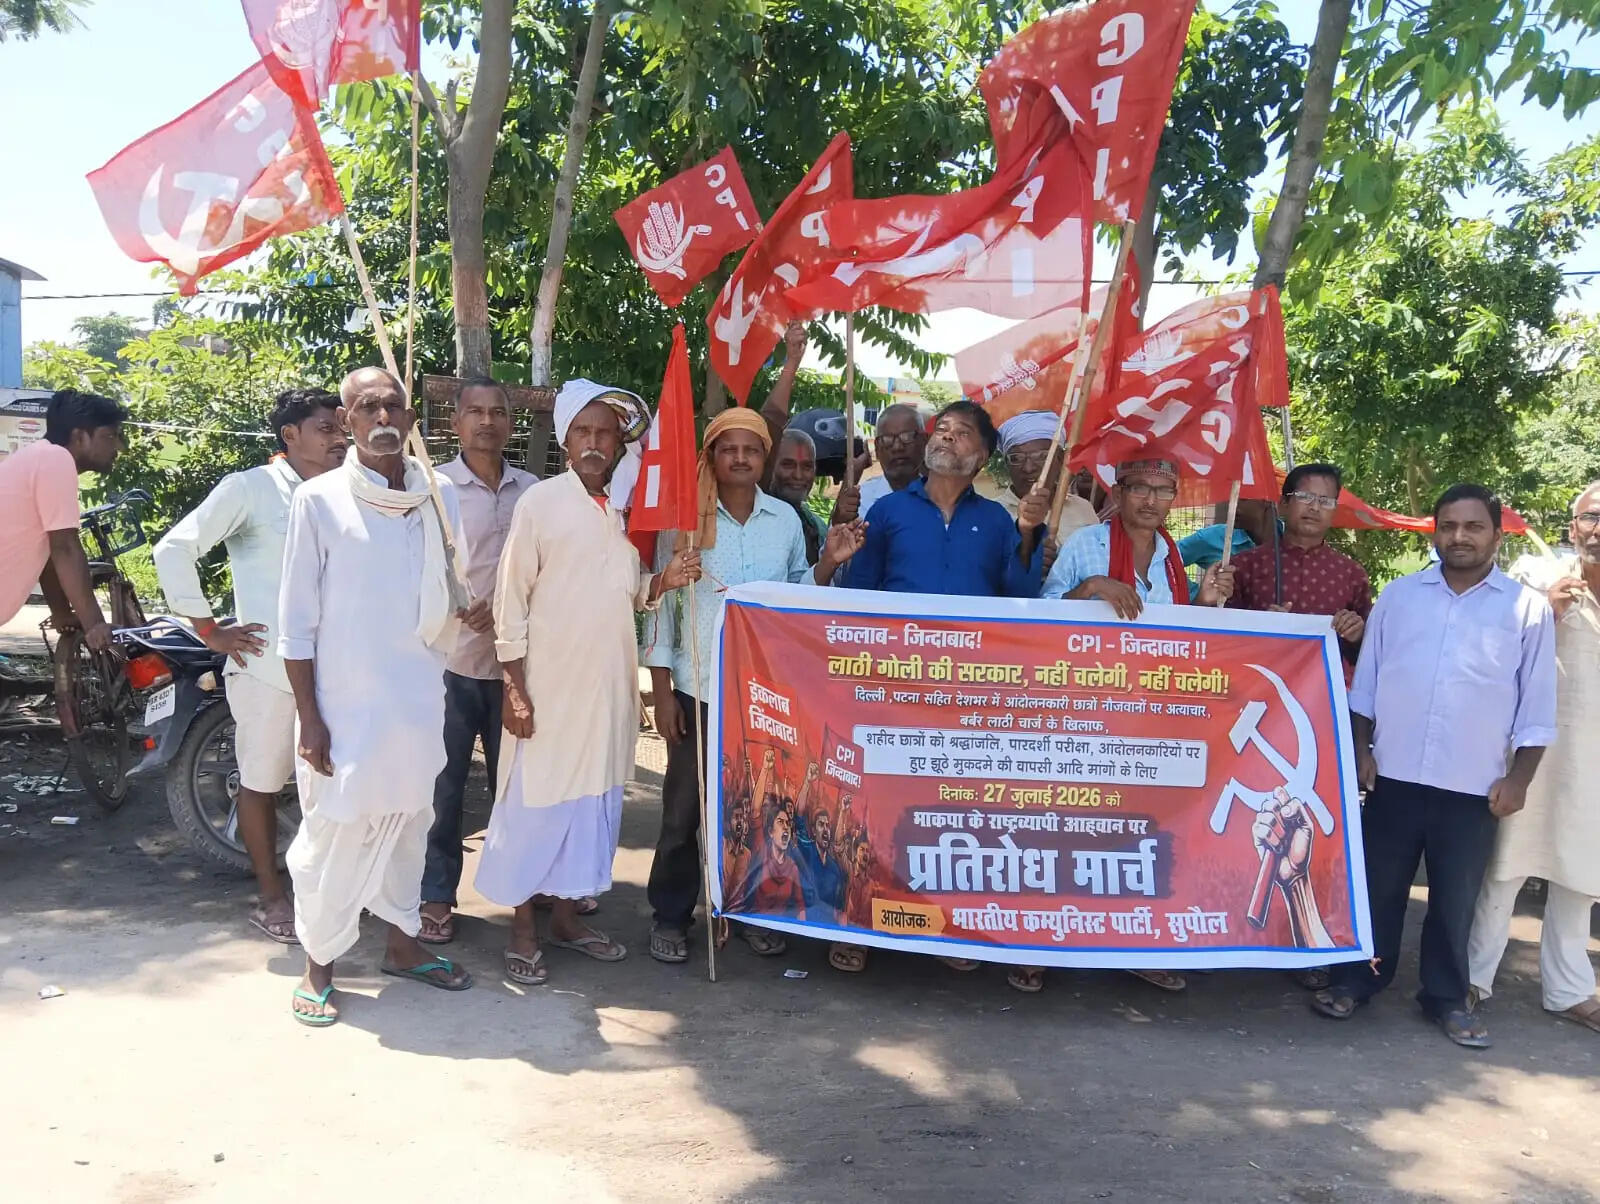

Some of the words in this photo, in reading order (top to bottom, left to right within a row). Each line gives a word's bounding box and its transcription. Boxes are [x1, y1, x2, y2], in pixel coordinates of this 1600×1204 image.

[904, 623, 983, 649] जिन्दाबाद!
[1067, 633, 1101, 653] CPI
[828, 652, 873, 677] लाठी
[877, 654, 923, 680] गोली
[928, 655, 952, 681] की
[957, 662, 1029, 688] सरकार,
[1034, 660, 1072, 686] नहीं
[1074, 662, 1133, 692] चलेगी,
[1139, 664, 1173, 690] नहीं
[1175, 667, 1230, 694] चलेगी!
[748, 677, 790, 716] इंकलाब
[855, 685, 886, 702] दिल्ली
[924, 690, 952, 707] सहित
[956, 690, 988, 708] देशभर
[991, 692, 1001, 707] में
[1004, 693, 1069, 710] आंदोलनकारी
[1073, 696, 1098, 711] छात्रों
[1102, 696, 1147, 714] नौजवानों
[1150, 702, 1162, 715] पर
[1166, 702, 1211, 719] अत्याचार,
[960, 711, 984, 728] बर्बर
[987, 713, 1014, 728] लाठी
[1018, 714, 1043, 729] चार्ज
[1046, 714, 1058, 730] के
[1063, 715, 1109, 734] खिलाफ,
[836, 745, 855, 766] CPI
[866, 729, 895, 747] शहीद
[899, 730, 926, 748] छात्रों
[930, 731, 945, 748] को
[949, 733, 1003, 752] श्रद्धांजलि,
[1008, 735, 1051, 752] पारदर्शी
[1055, 737, 1094, 756] परीक्षा,
[1098, 739, 1182, 758] आंदोलनकारियों
[1186, 746, 1200, 759] पर
[909, 756, 927, 774] हुए
[931, 753, 949, 775] झूठे
[953, 755, 993, 775] मुकदमे
[997, 755, 1013, 773] की
[1016, 757, 1052, 774] वापसी
[1056, 758, 1083, 777] आदि
[1087, 761, 1116, 777] मांगों
[1120, 761, 1131, 777] के
[1135, 764, 1158, 780] लिए
[983, 783, 1006, 803] 27
[1010, 784, 1053, 810] जुलाई
[1055, 785, 1101, 807] 2026
[1105, 790, 1122, 807] को
[967, 809, 985, 830] के
[987, 811, 1060, 834] राष्ट्रव्यापी
[1128, 818, 1149, 835] पर
[906, 832, 1059, 894] प्रतिरोध
[1072, 838, 1158, 896] मार्च
[881, 906, 931, 929] आयोजक:
[952, 902, 1019, 931] भारतीय
[1020, 904, 1106, 942] कम्युनिस्ट
[1109, 906, 1161, 940] पार्टी,
[1165, 905, 1229, 943] सुपौल
